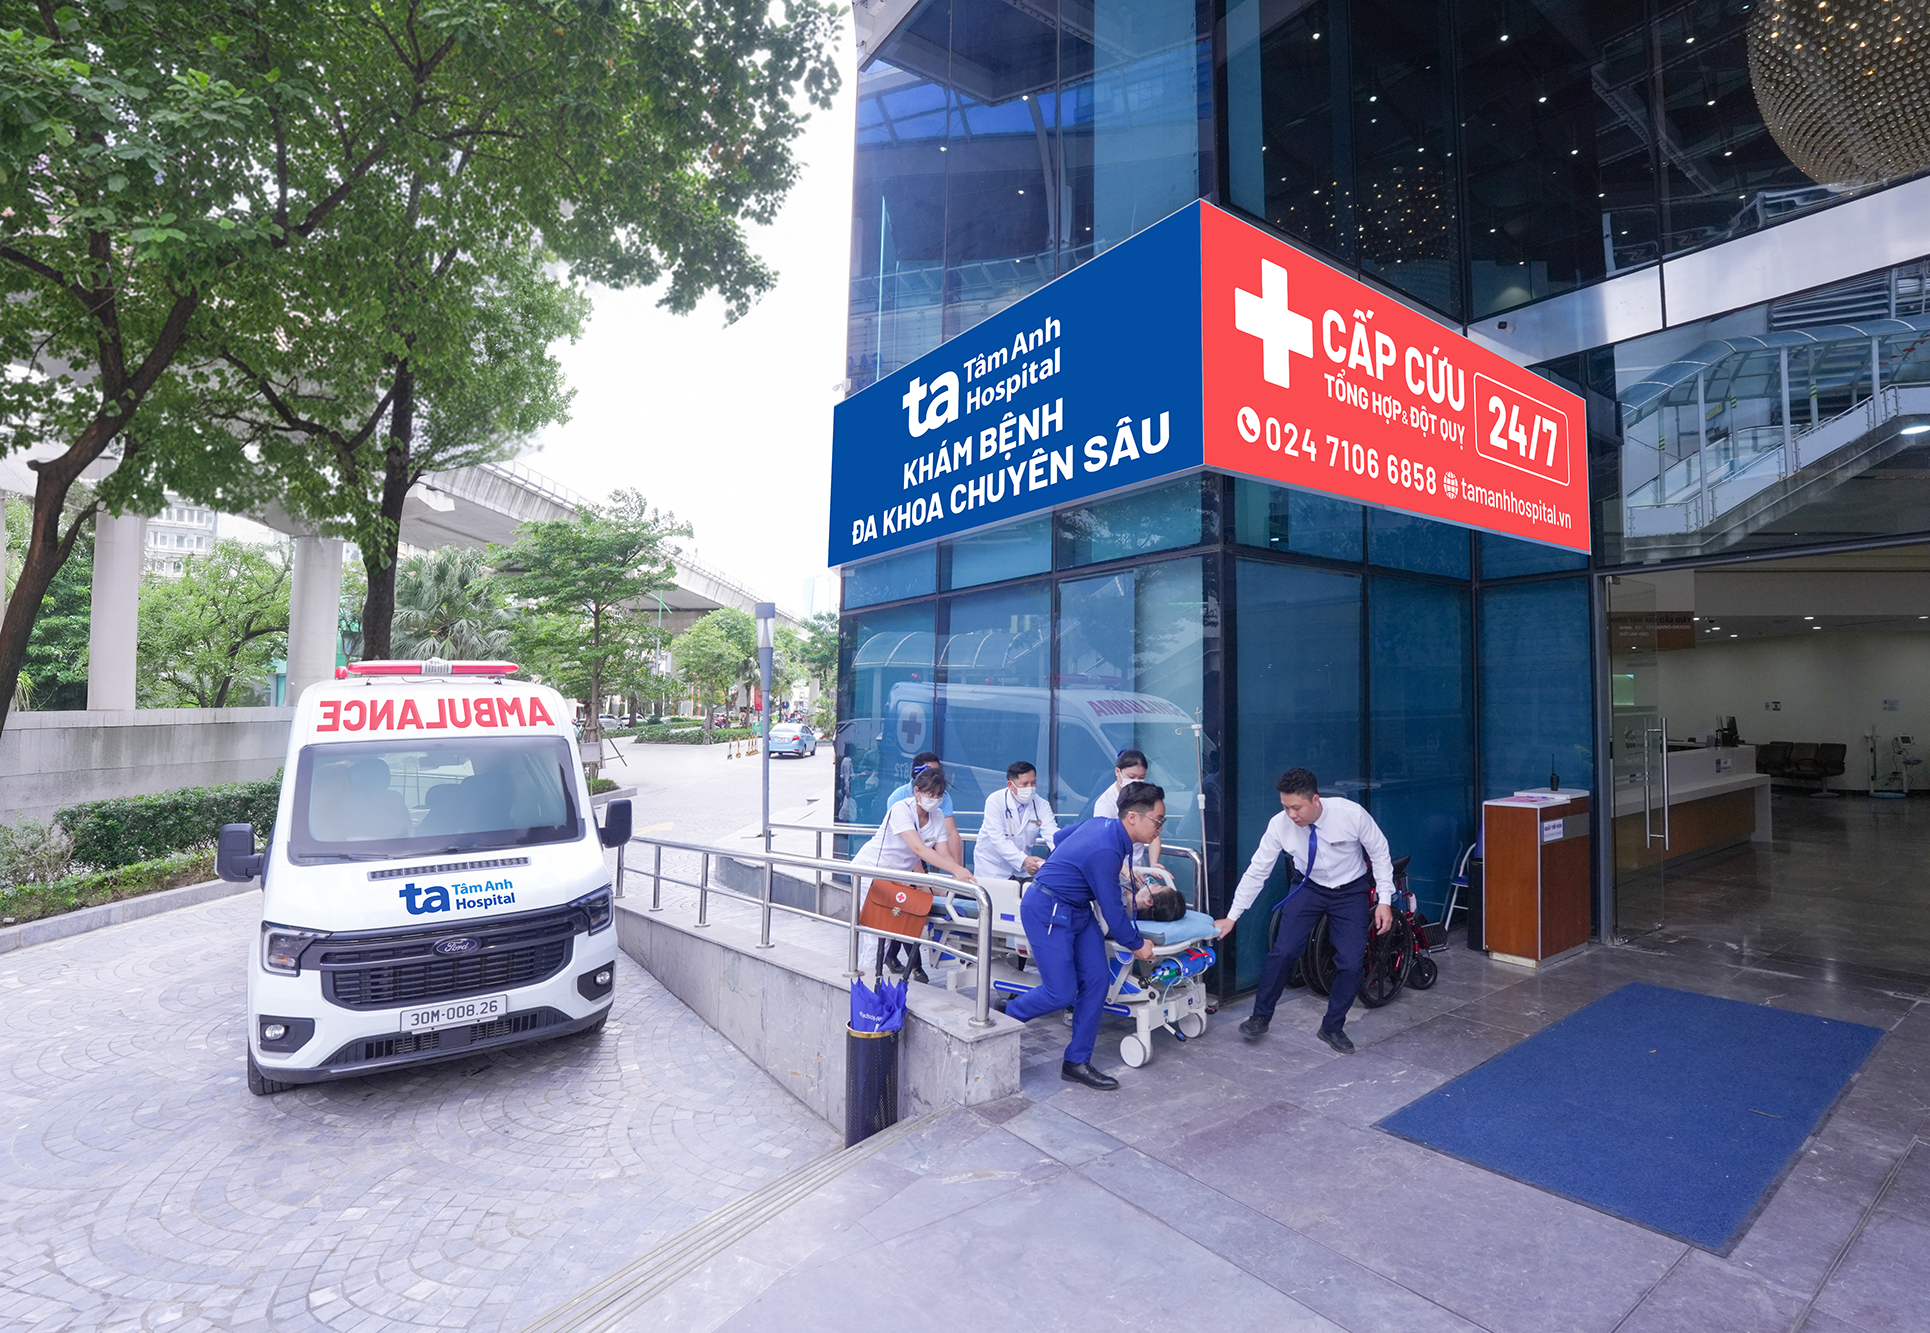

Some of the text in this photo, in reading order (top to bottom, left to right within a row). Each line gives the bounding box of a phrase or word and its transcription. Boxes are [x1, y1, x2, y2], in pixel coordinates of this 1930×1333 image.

[964, 317, 1061, 384] Tâm Anh
[967, 347, 1061, 415] Hospital
[1322, 308, 1465, 412] CẤP CỨU
[903, 371, 960, 438] ta
[1324, 369, 1369, 410] TỔNG
[1439, 418, 1465, 451] QUỴ
[1489, 396, 1558, 467] 24/7
[903, 398, 1064, 490] KHÁM BỆNH
[1266, 417, 1437, 496] 024 7106 6858
[850, 411, 1170, 546] ĐA KHOA CHUYÊN SÂU
[1460, 478, 1572, 530] tamanhhospital.vn
[1087, 699, 1188, 717] AMBULANCE
[399, 883, 451, 915] ta
[451, 878, 514, 895] Tâm Anh
[456, 892, 516, 911] Hospital
[444, 939, 470, 952] Ford
[410, 1000, 498, 1026] 30M-008.26
